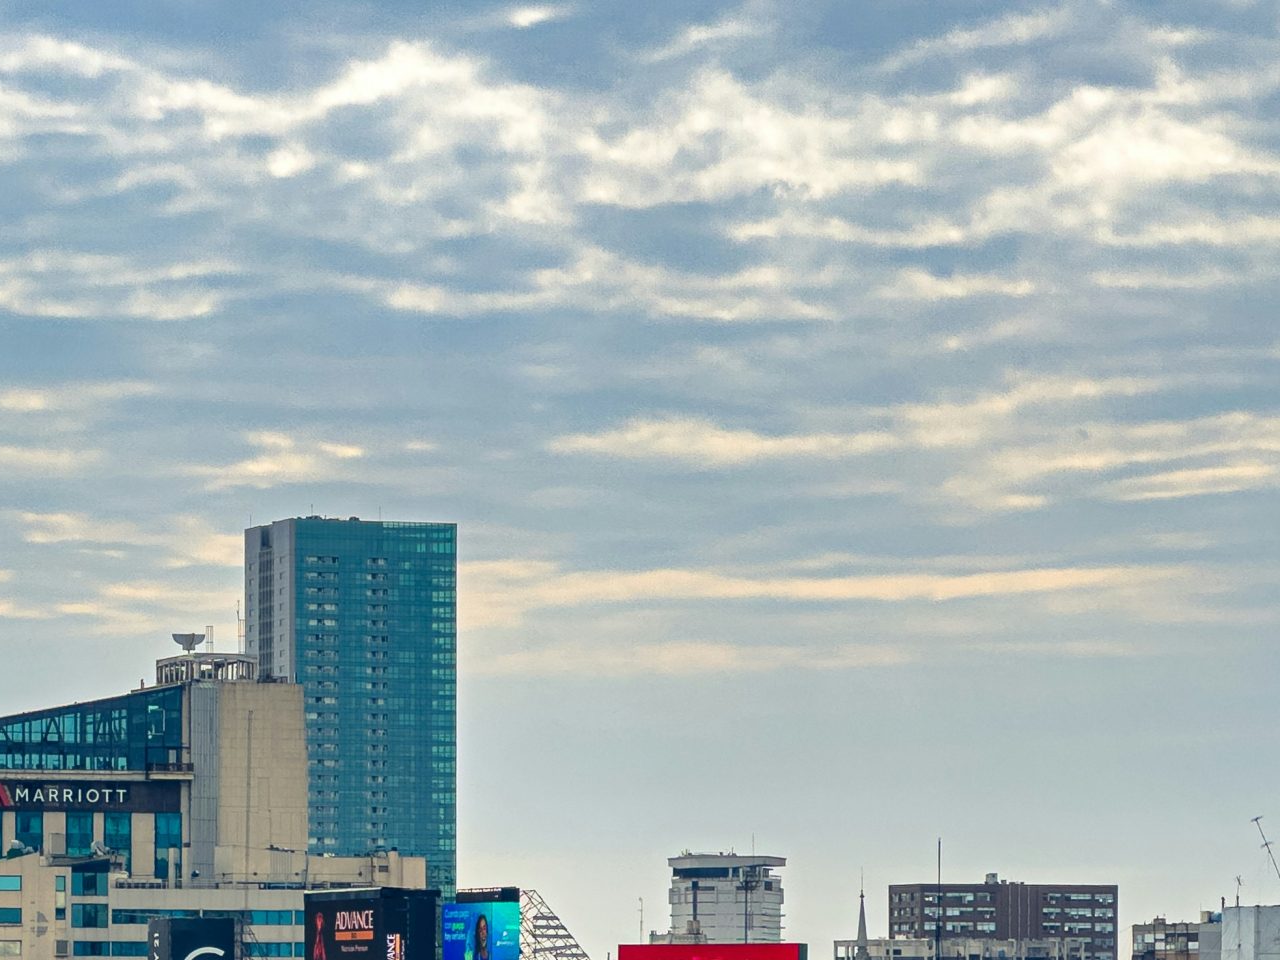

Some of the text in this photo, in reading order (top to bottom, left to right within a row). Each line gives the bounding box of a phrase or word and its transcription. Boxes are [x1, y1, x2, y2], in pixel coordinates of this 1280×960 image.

[15, 788, 127, 803] MARRIOTT
[334, 910, 373, 930] ADVANCE
[153, 933, 160, 948] 21
